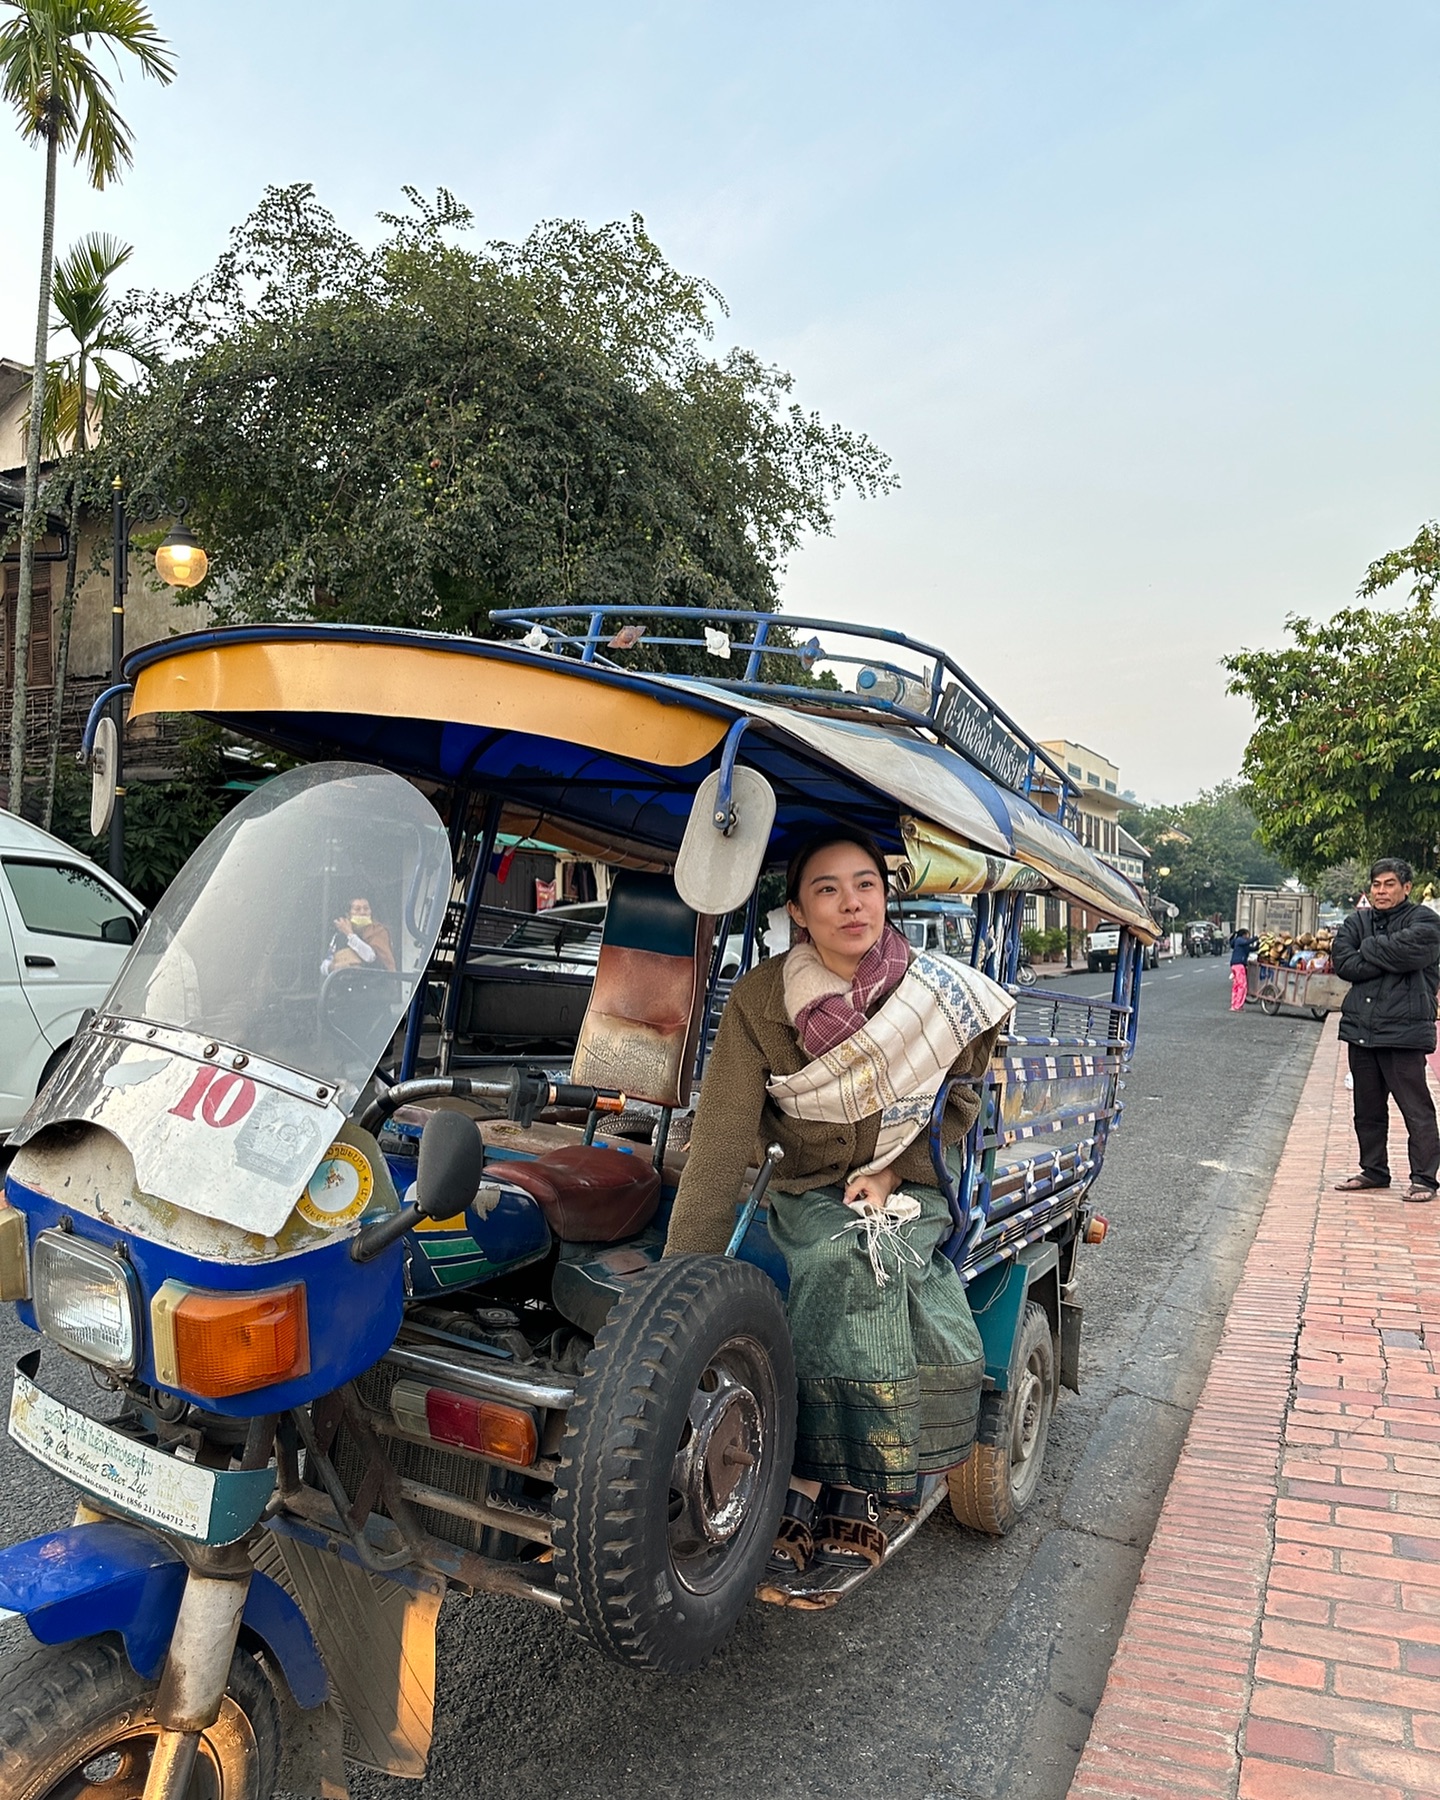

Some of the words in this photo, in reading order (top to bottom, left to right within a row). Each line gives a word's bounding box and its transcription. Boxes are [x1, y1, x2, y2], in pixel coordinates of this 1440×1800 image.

[167, 1065, 257, 1128] 10
[74, 1453, 100, 1473] About
[101, 1463, 127, 1487] Better
[127, 1477, 149, 1500] Life
[112, 1488, 126, 1502] Tel:
[126, 1496, 143, 1510] (856
[143, 1503, 156, 1516] 21)
[156, 1509, 184, 1527] 264712
[191, 1523, 197, 1532] 5
